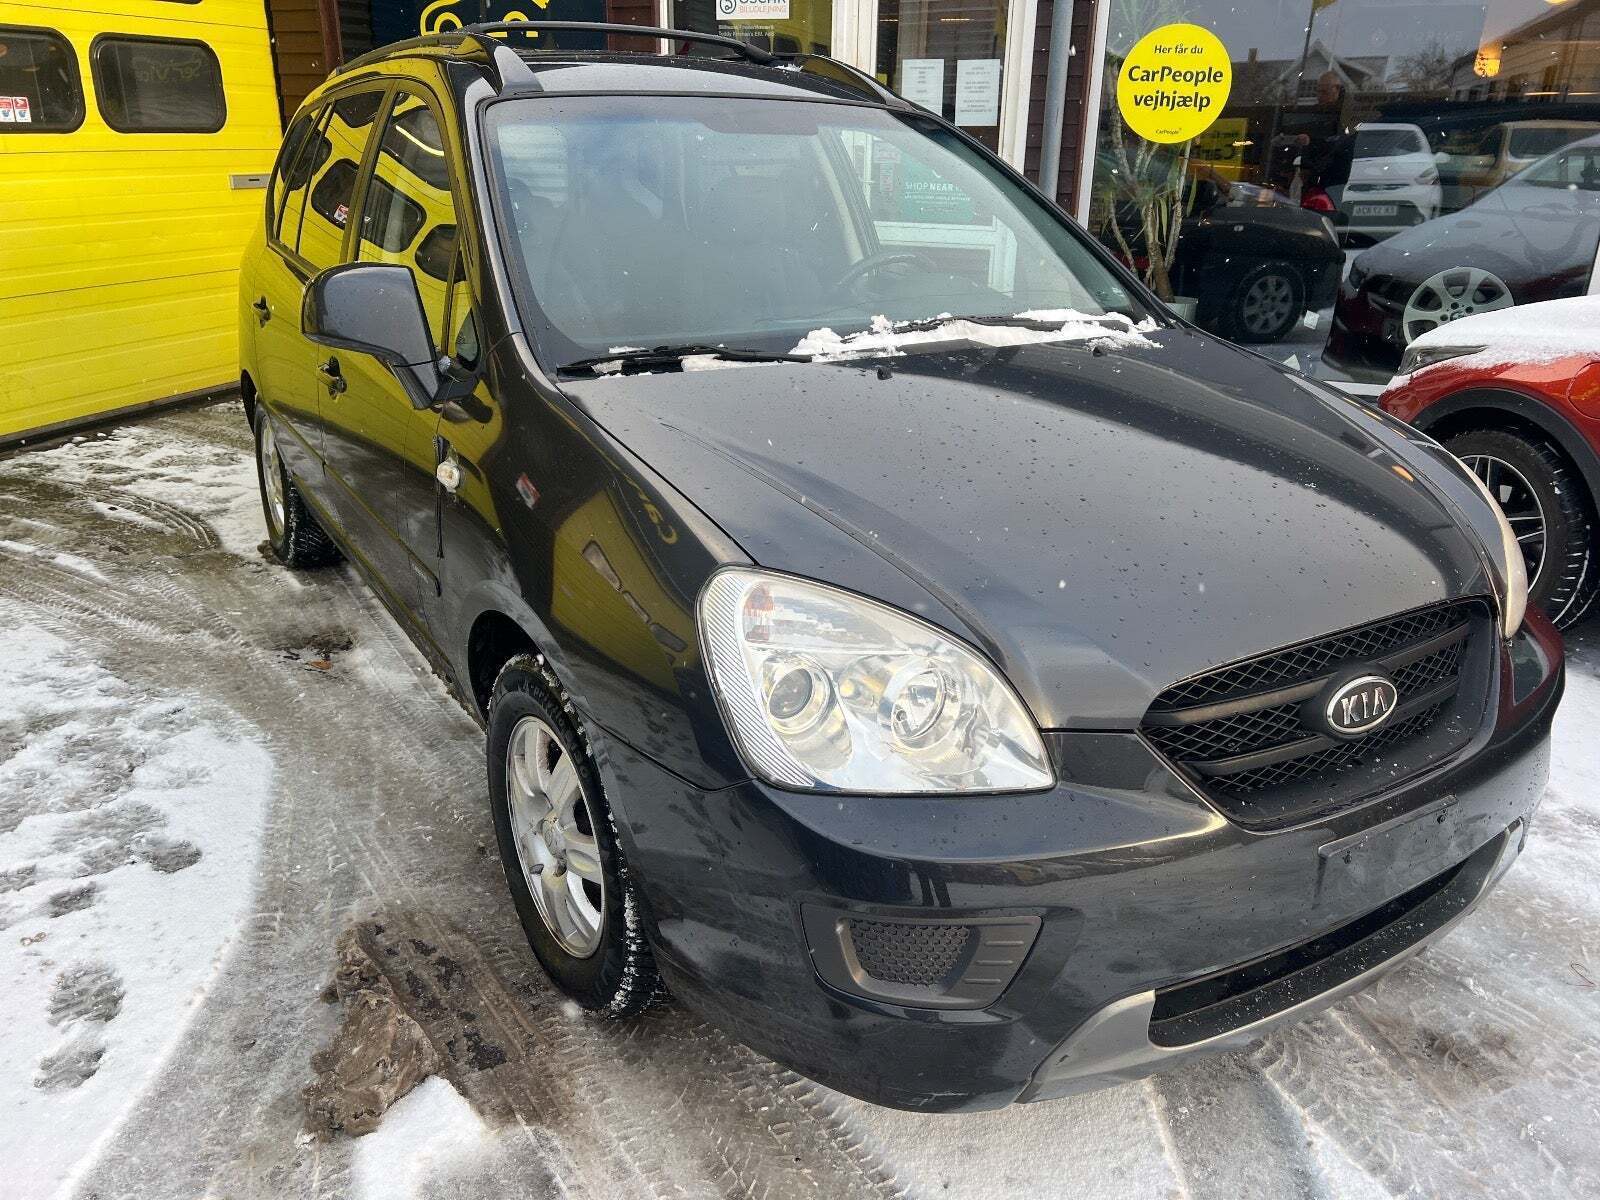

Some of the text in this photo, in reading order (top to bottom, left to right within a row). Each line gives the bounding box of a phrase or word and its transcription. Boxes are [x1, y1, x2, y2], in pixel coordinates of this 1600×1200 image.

[1154, 43, 1203, 54] Her får du
[1128, 65, 1224, 87] CarPeople
[1133, 90, 1211, 112] vejhjælp
[1341, 687, 1388, 725] KIA
